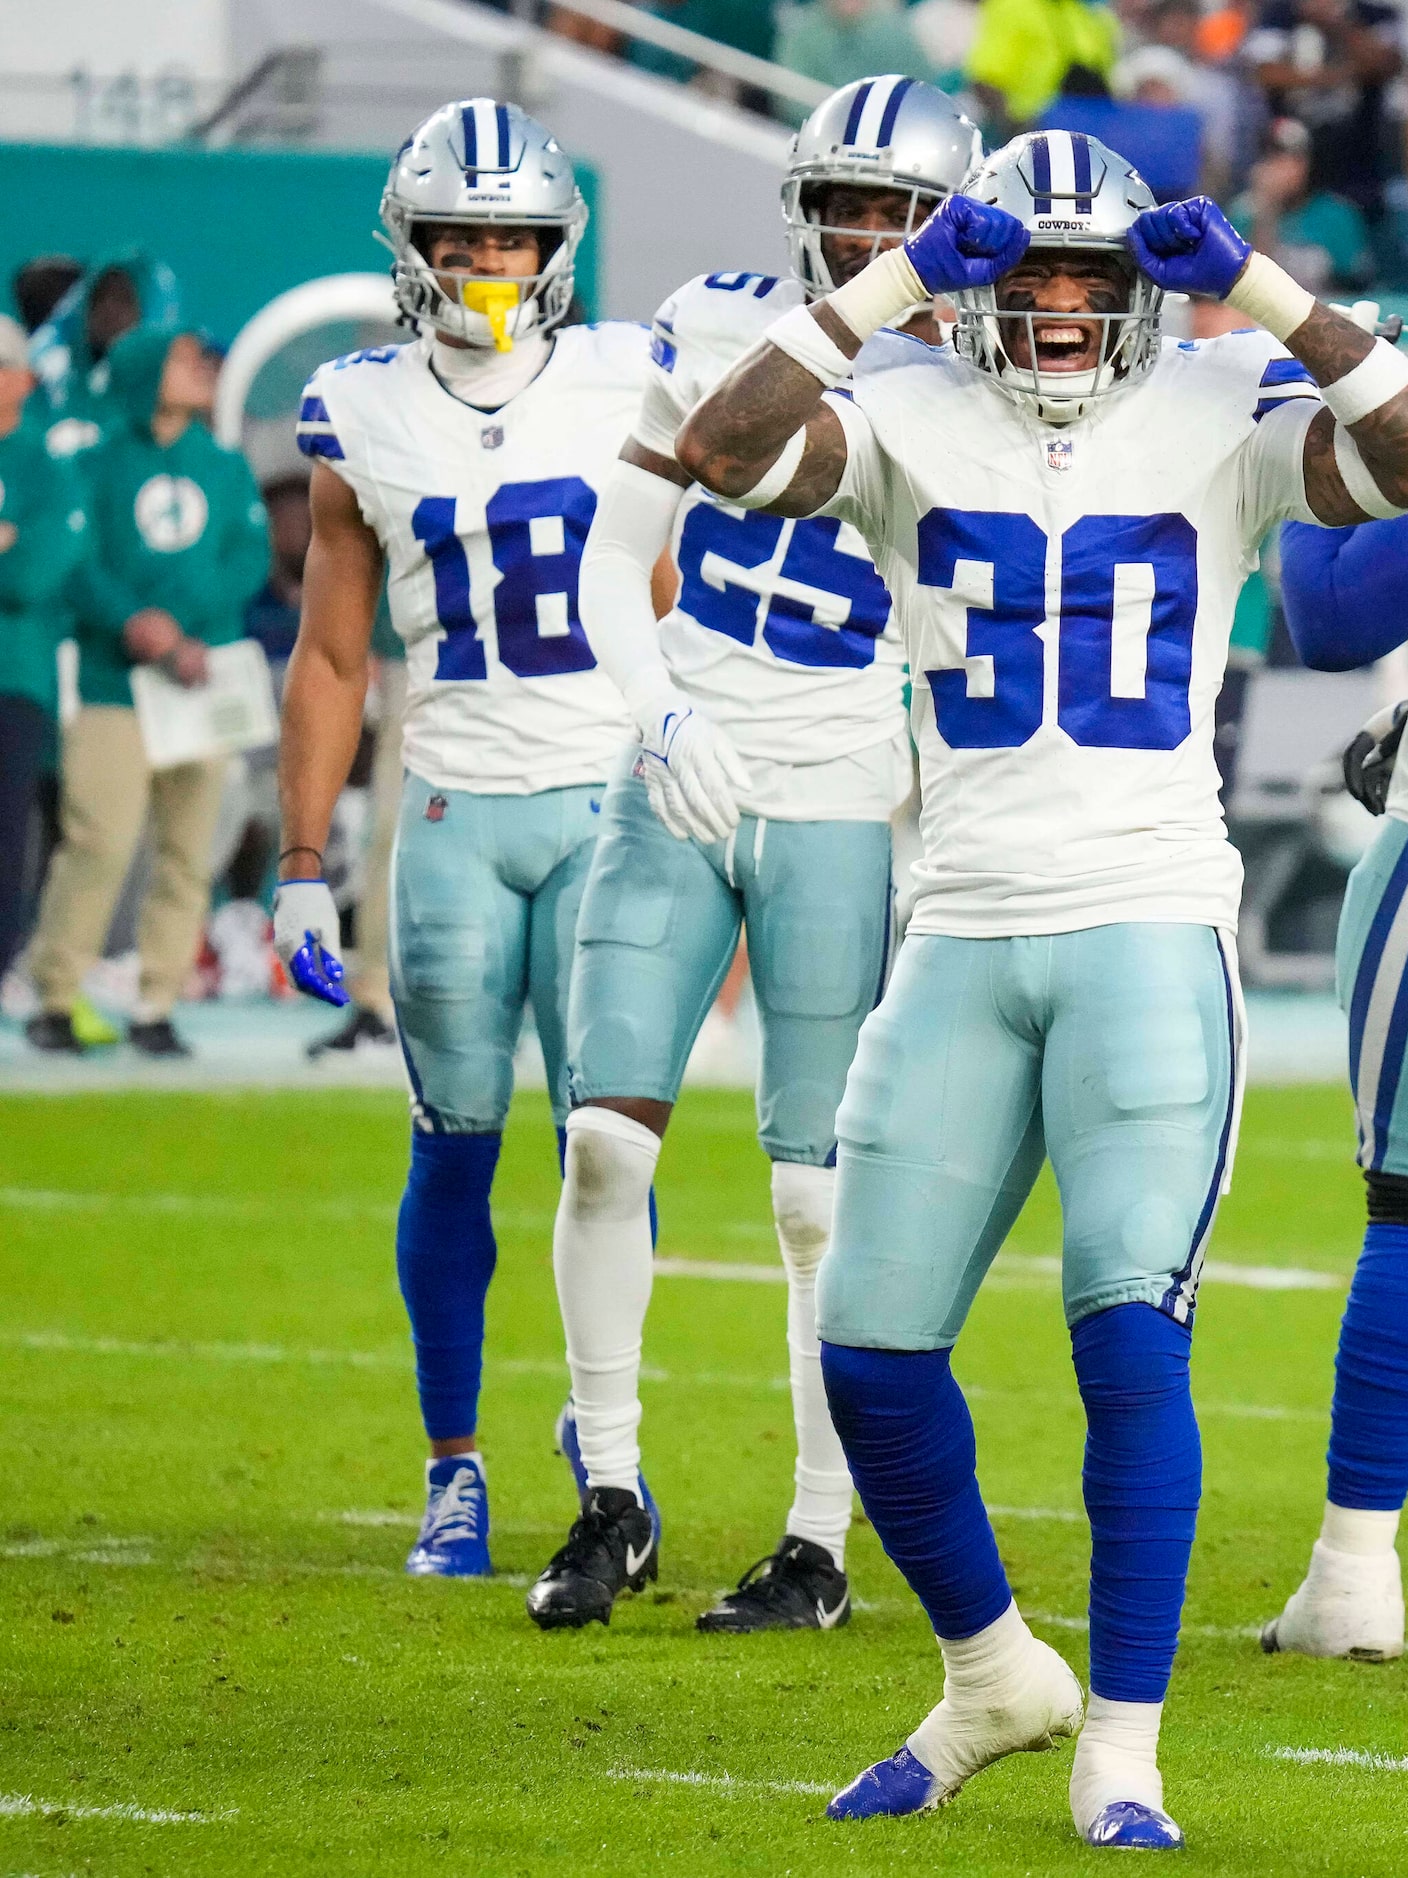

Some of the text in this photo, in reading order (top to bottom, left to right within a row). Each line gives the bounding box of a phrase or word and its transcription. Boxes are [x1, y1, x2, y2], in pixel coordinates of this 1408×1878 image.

[411, 474, 598, 681] 18
[677, 500, 893, 670] 25
[917, 506, 1199, 751] 30
